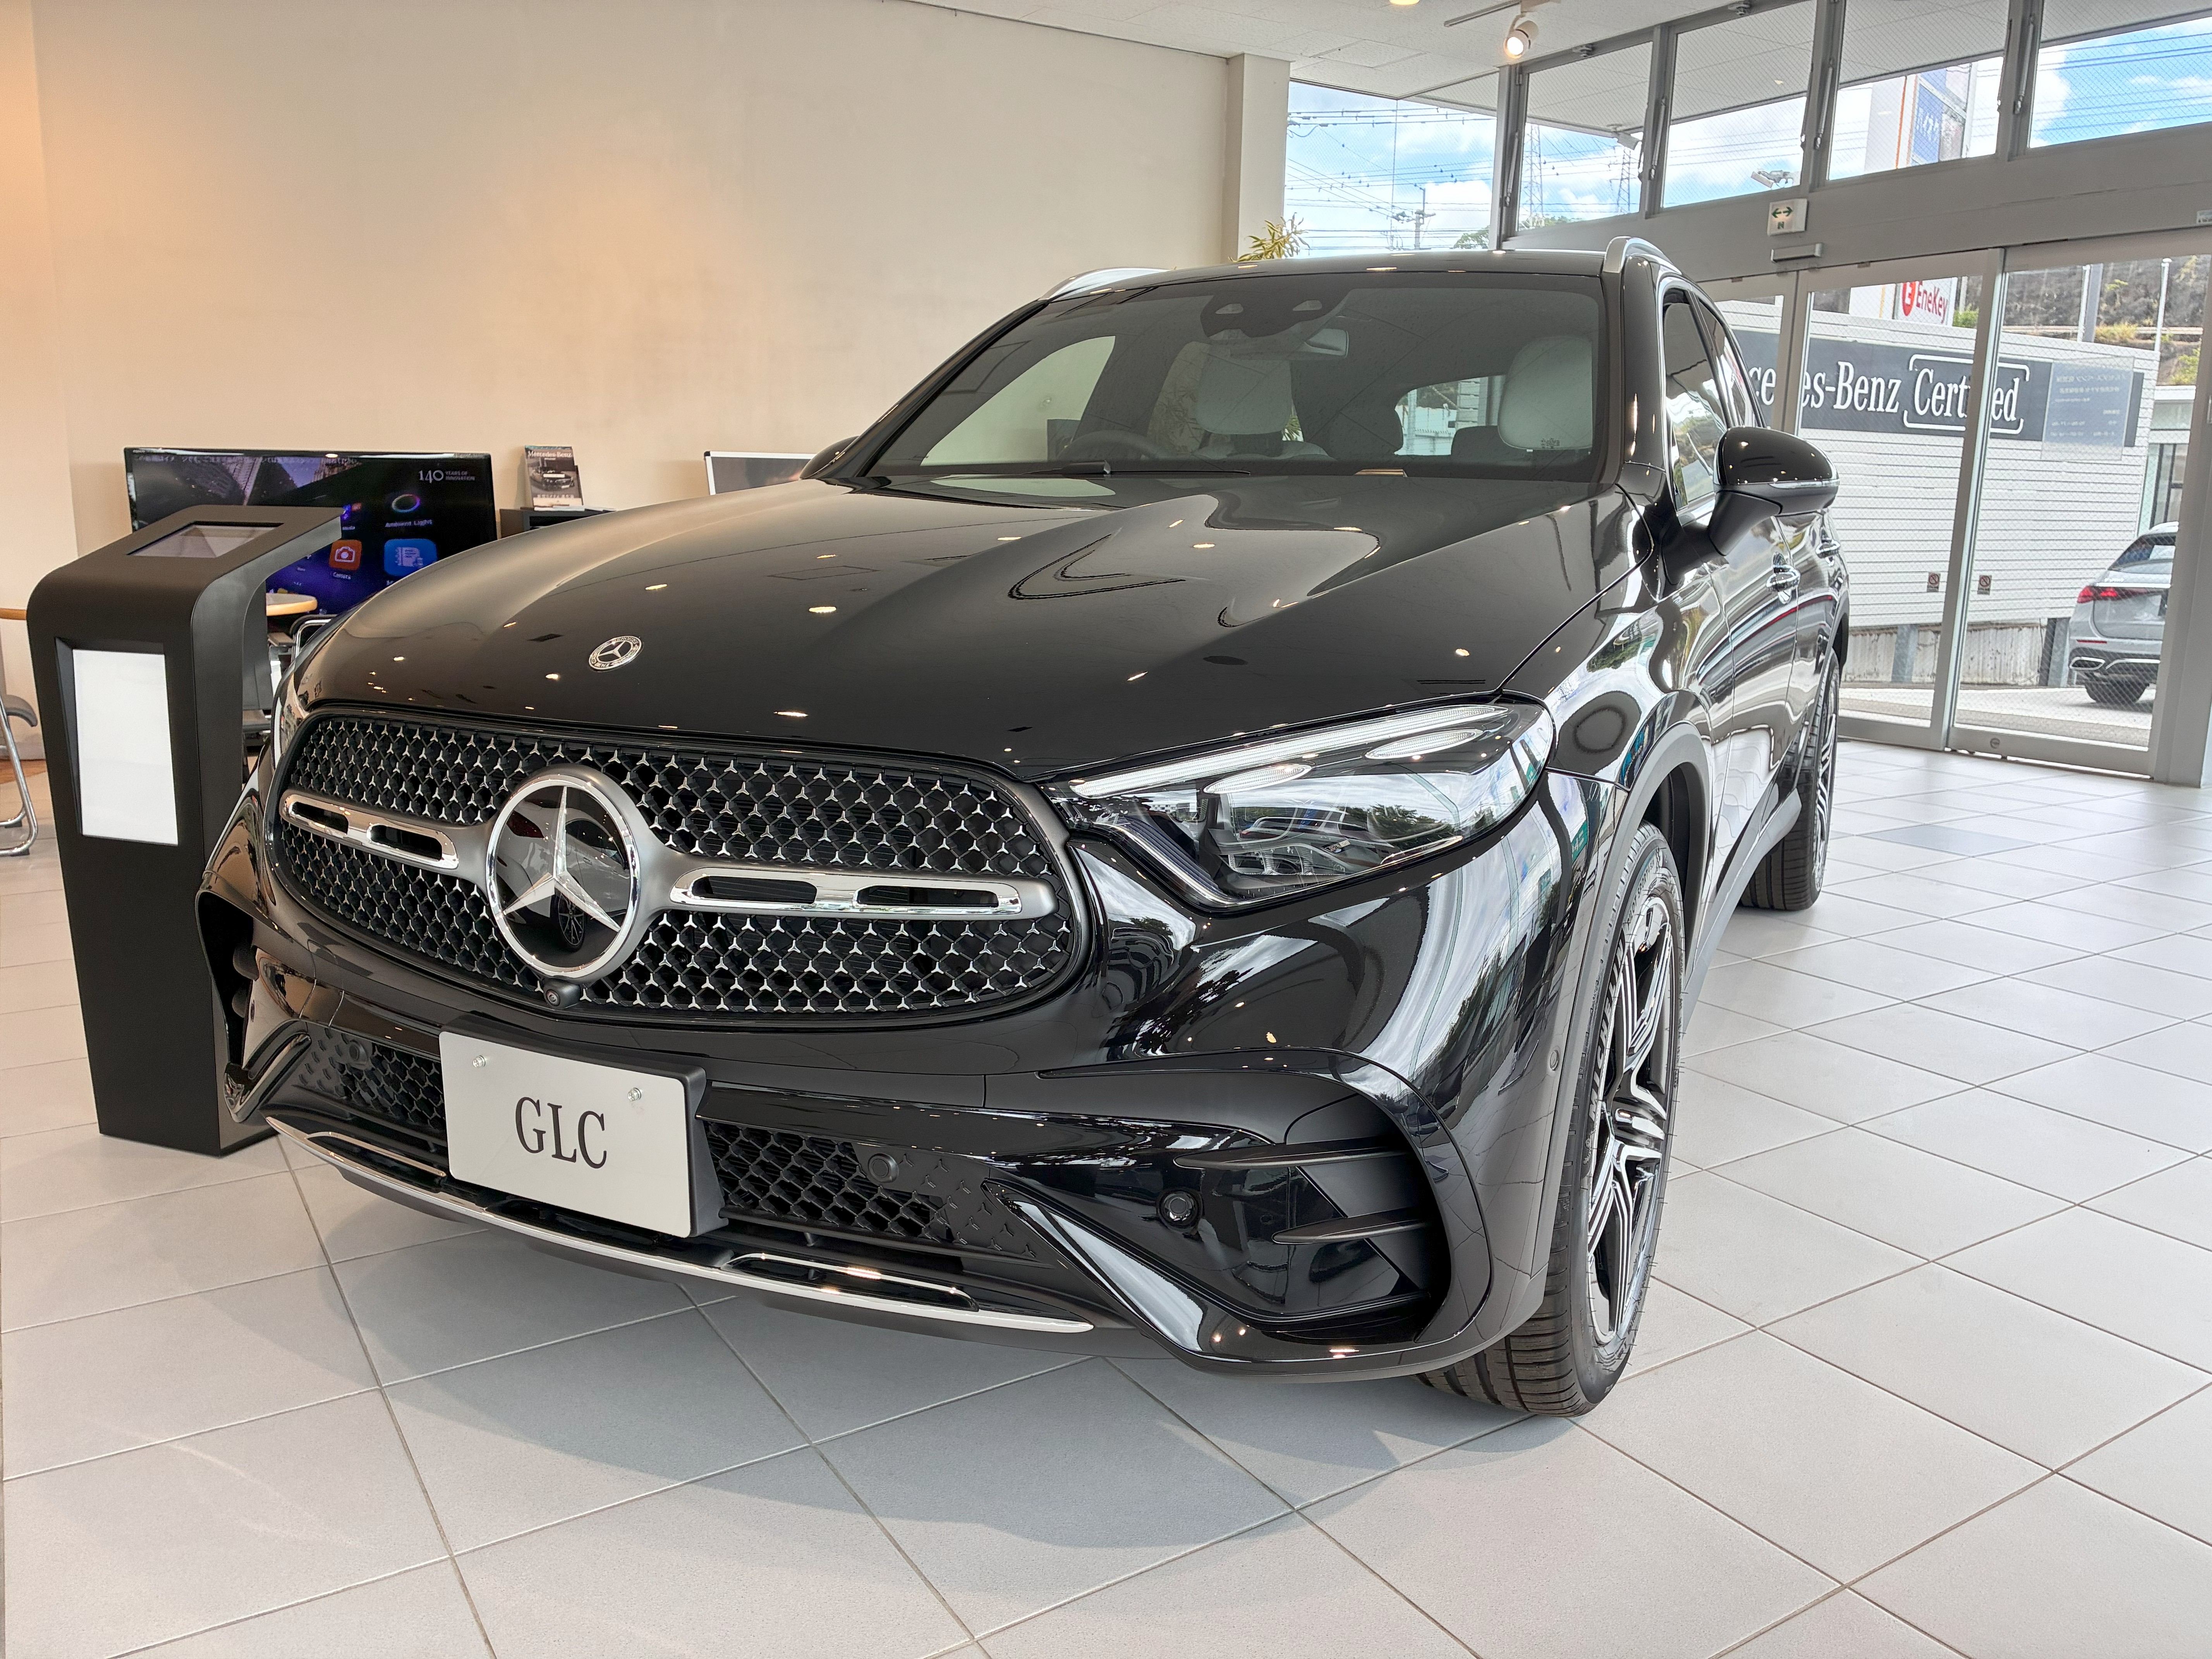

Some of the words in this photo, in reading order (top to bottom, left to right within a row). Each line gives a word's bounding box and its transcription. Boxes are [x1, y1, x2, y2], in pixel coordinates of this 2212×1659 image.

[1916, 281, 1948, 323] EneKey
[1914, 368, 2020, 421] Certed
[419, 470, 444, 484] 140
[1589, 938, 1622, 1121] MICHELIN
[515, 1097, 607, 1169] GLC
